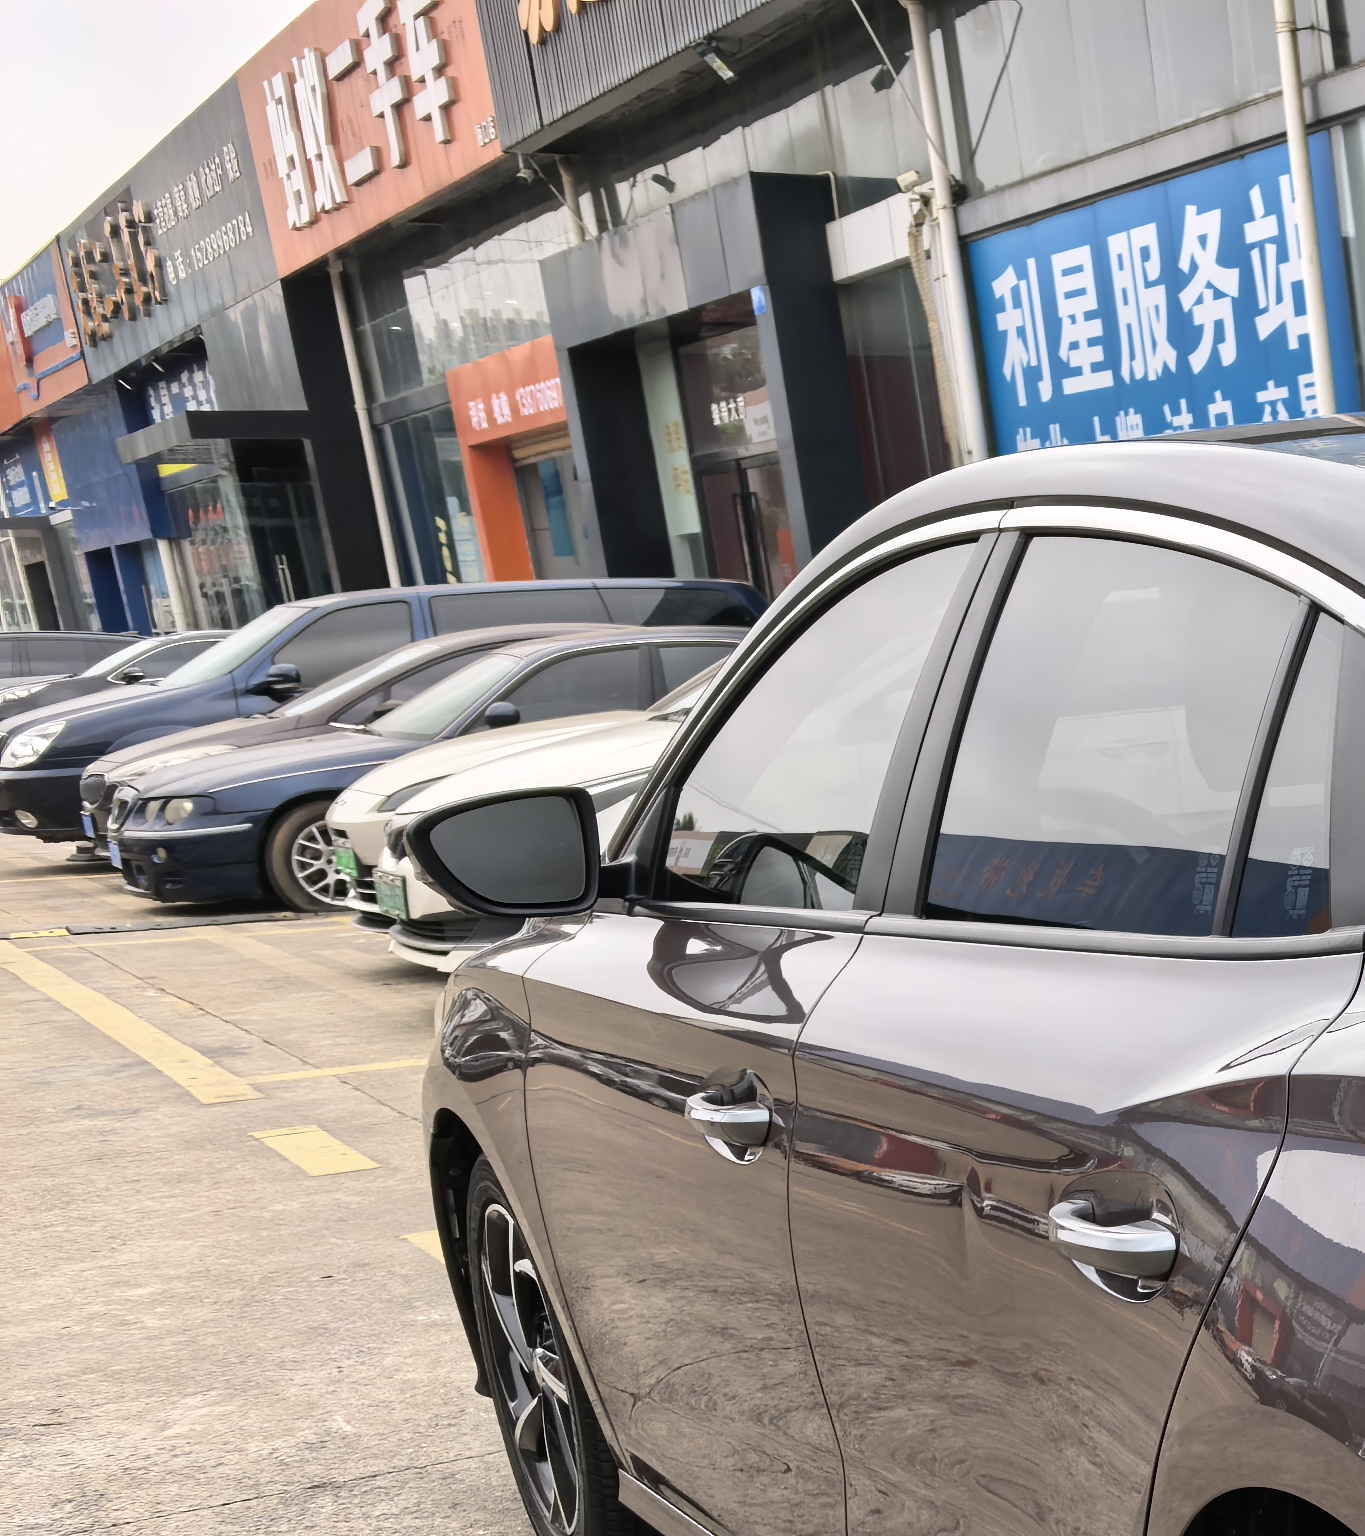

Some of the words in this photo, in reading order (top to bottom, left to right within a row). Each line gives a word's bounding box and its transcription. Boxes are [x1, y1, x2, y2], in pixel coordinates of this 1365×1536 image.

[263, 0, 457, 231] 蚂蚁二手车
[990, 174, 1312, 407] 利星服务站
